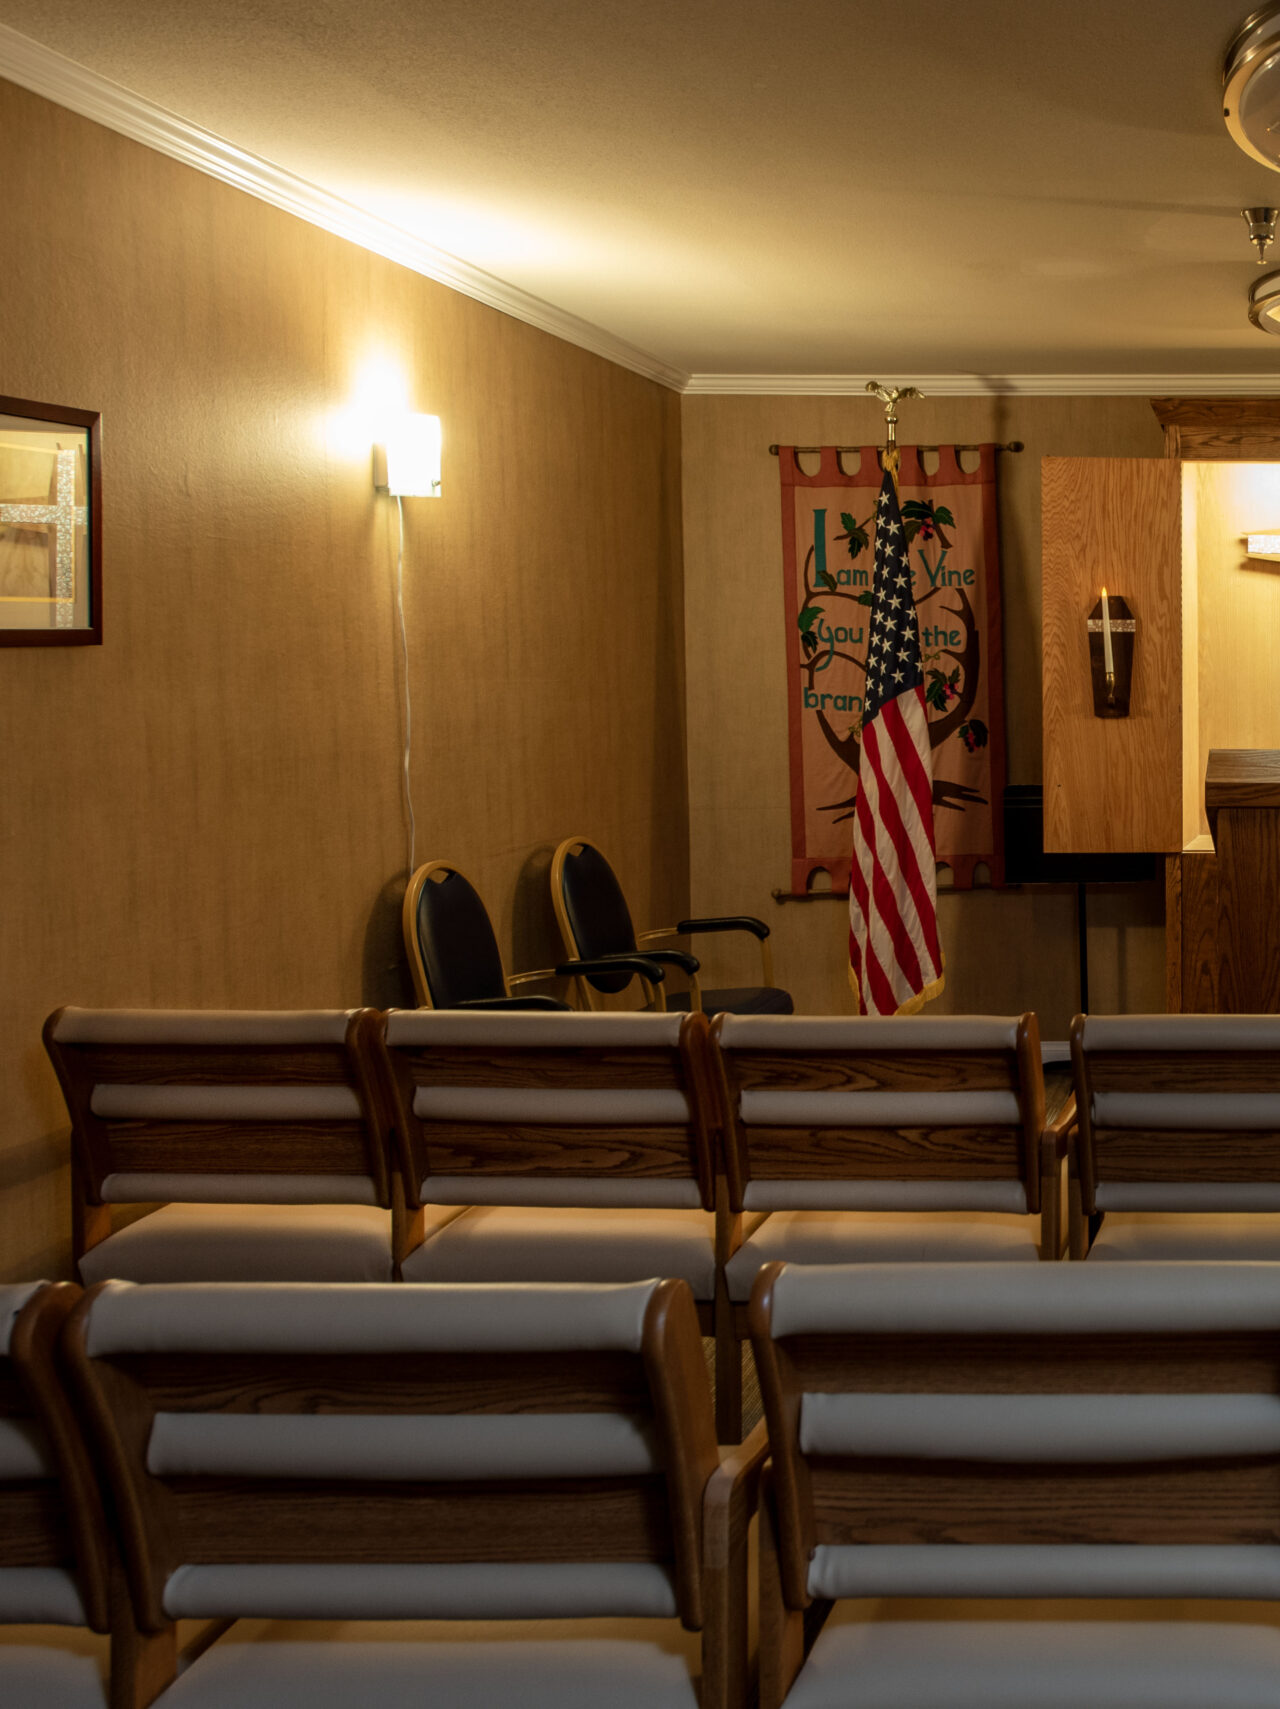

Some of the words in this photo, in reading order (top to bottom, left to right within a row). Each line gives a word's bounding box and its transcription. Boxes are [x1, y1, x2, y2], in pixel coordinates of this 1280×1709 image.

[813, 508, 828, 588] I
[836, 568, 869, 587] am
[917, 549, 976, 588] Vine
[922, 625, 963, 648] the
